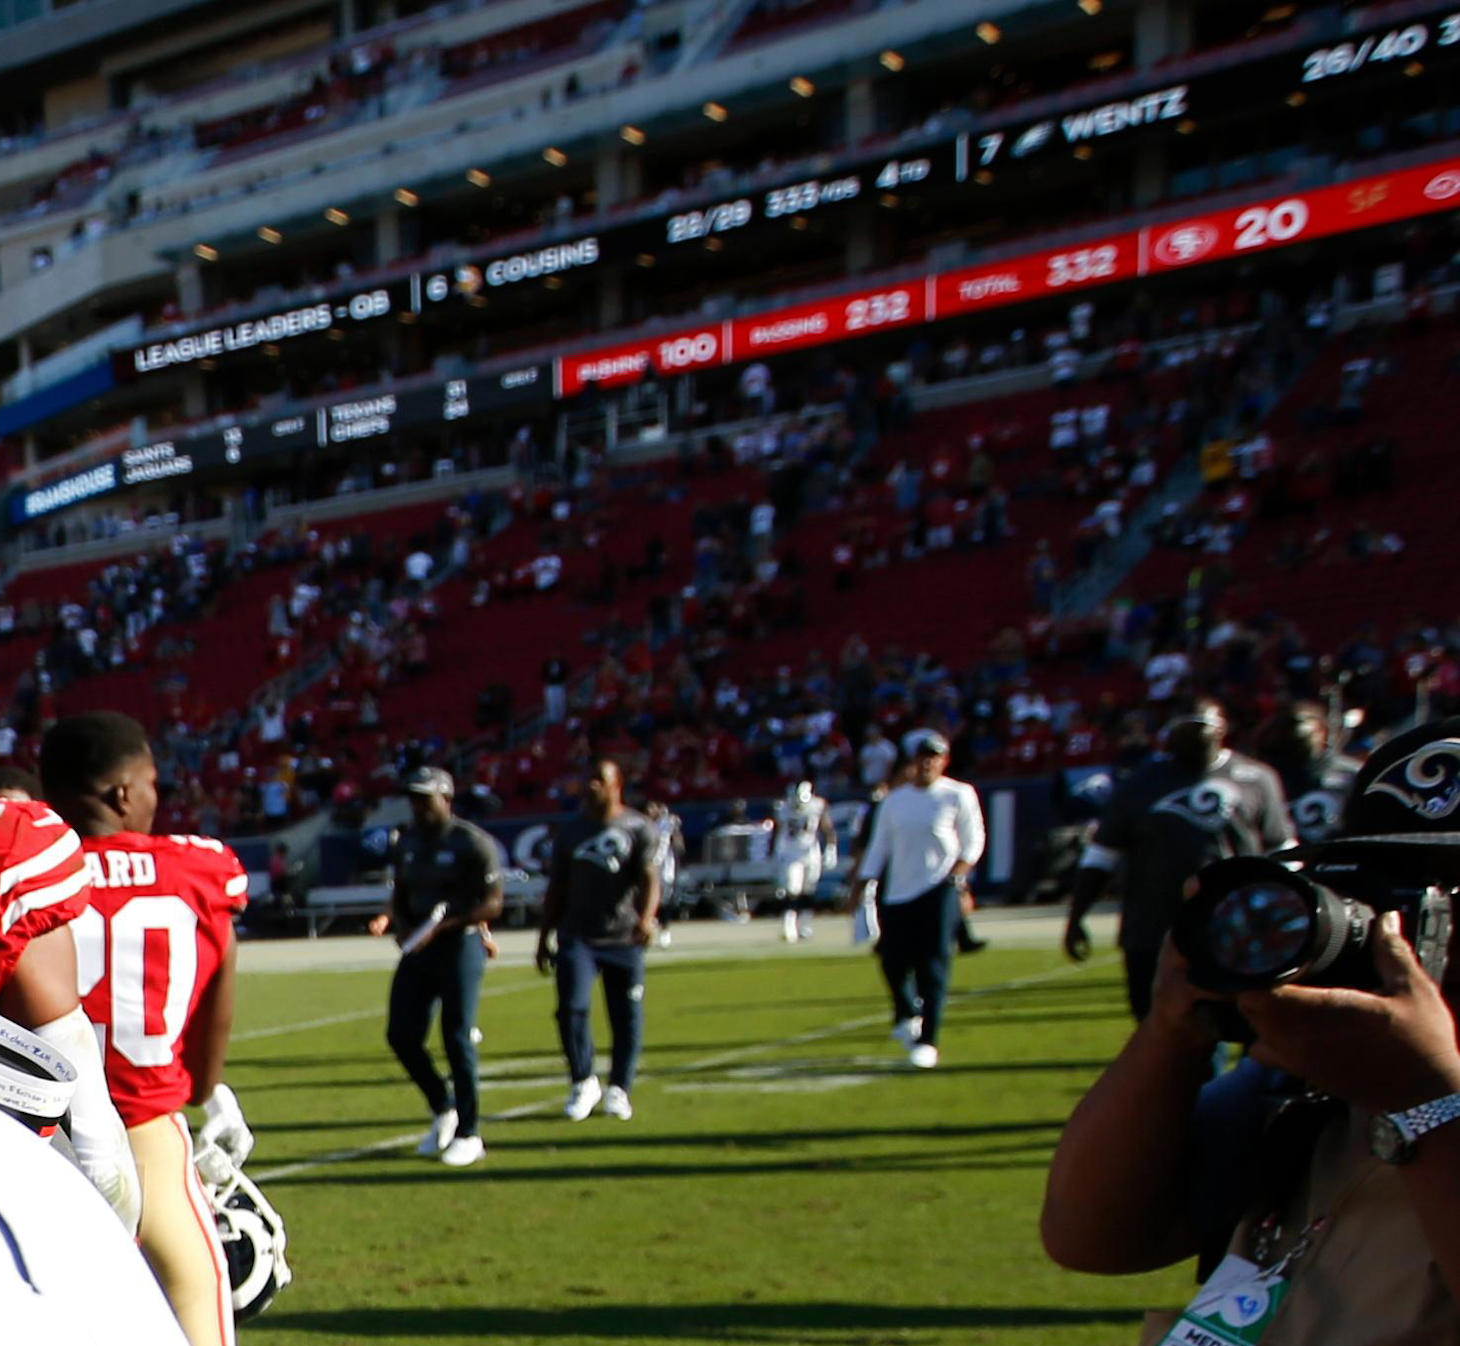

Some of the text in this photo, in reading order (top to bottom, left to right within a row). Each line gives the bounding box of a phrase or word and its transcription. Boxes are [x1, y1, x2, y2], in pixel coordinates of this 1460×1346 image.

[1301, 24, 1430, 83] 26/40
[980, 86, 1188, 165] 7 WENTZ
[1233, 199, 1309, 250] 20
[426, 237, 600, 301] 6 COUSINS
[1045, 244, 1119, 288] 332
[845, 290, 911, 331] 232
[135, 329, 223, 373] LEAGUE
[223, 303, 333, 349] LEADERS
[658, 333, 718, 368] 100
[80, 850, 157, 888] ARD
